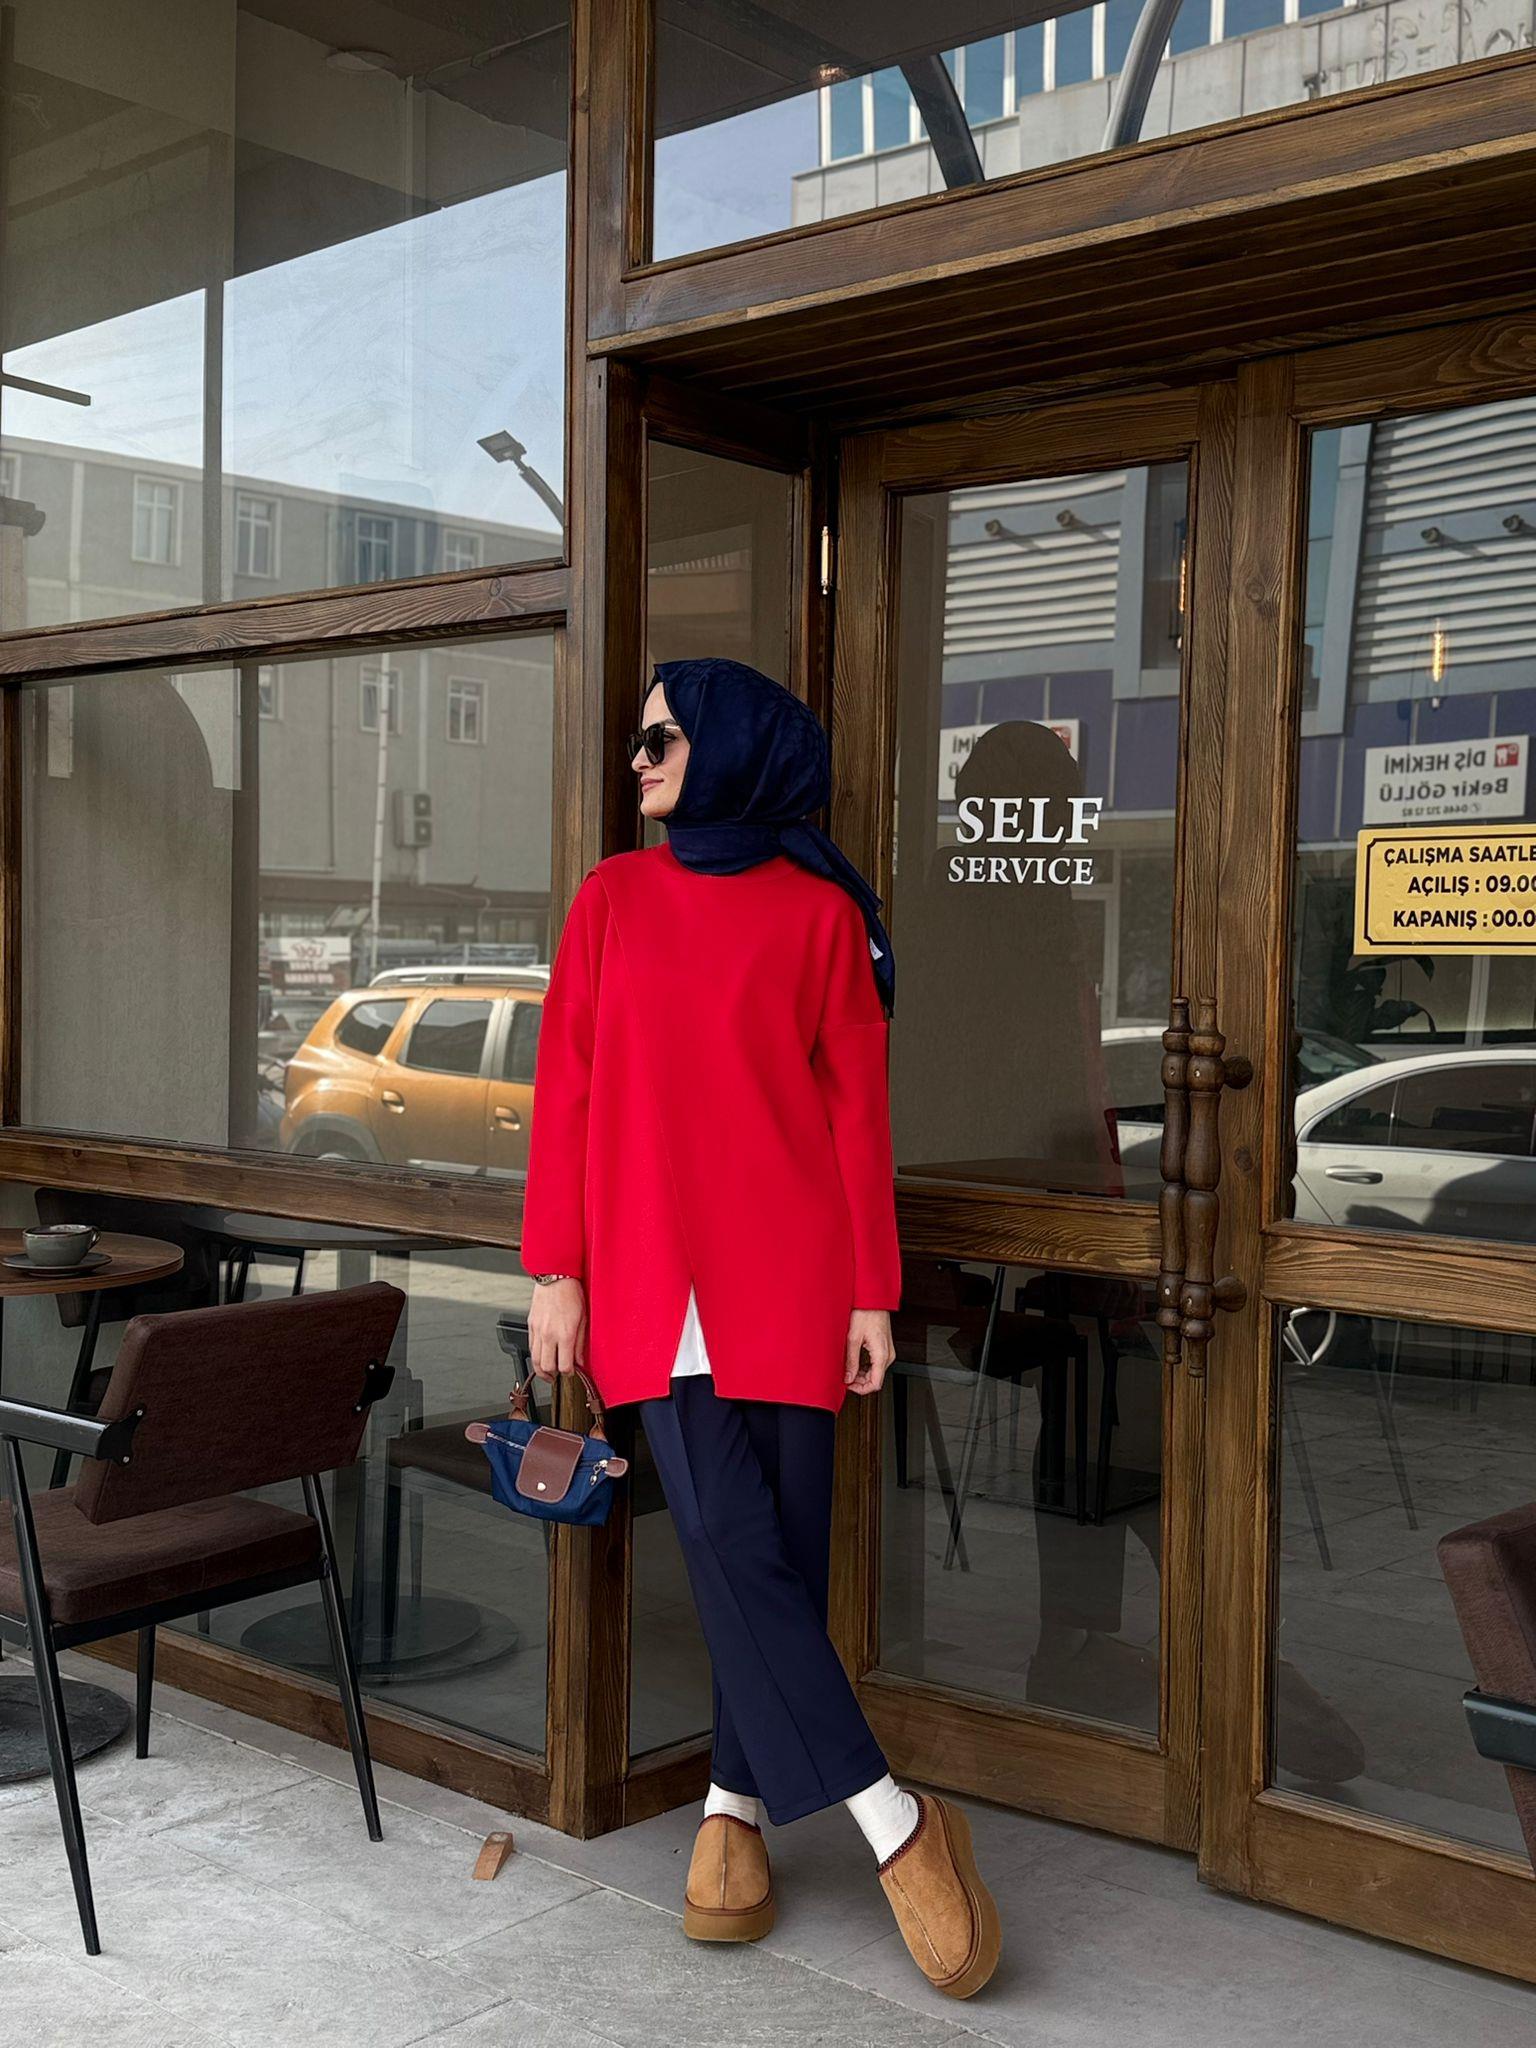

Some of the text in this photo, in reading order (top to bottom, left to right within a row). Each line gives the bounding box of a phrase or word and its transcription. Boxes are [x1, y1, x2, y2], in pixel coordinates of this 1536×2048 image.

[955, 797, 1103, 844] SELF
[1384, 847, 1464, 867] ÇALIŞMA
[948, 856, 1094, 885] SERVICE
[1407, 875, 1469, 896] AÇILIŞ
[1393, 910, 1477, 931] KAPANIŞ
[1492, 909, 1536, 927] 00.0
